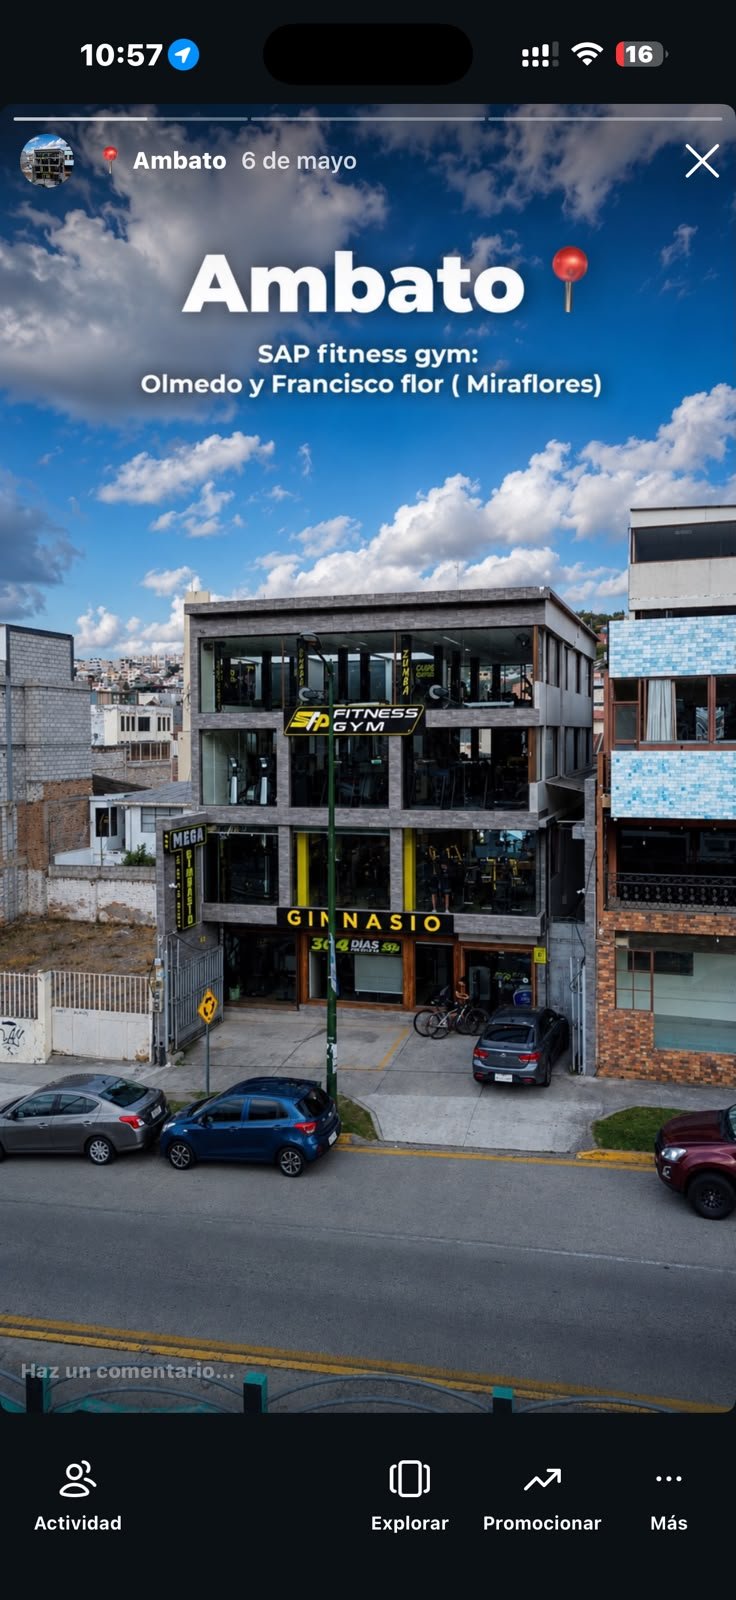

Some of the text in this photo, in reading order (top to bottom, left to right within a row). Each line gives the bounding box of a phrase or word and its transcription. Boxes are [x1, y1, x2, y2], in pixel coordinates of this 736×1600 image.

[402, 649, 410, 696] ZUMBA
[333, 708, 419, 718] FITNESS
[333, 721, 385, 731] GYM
[172, 827, 204, 849] MEGA
